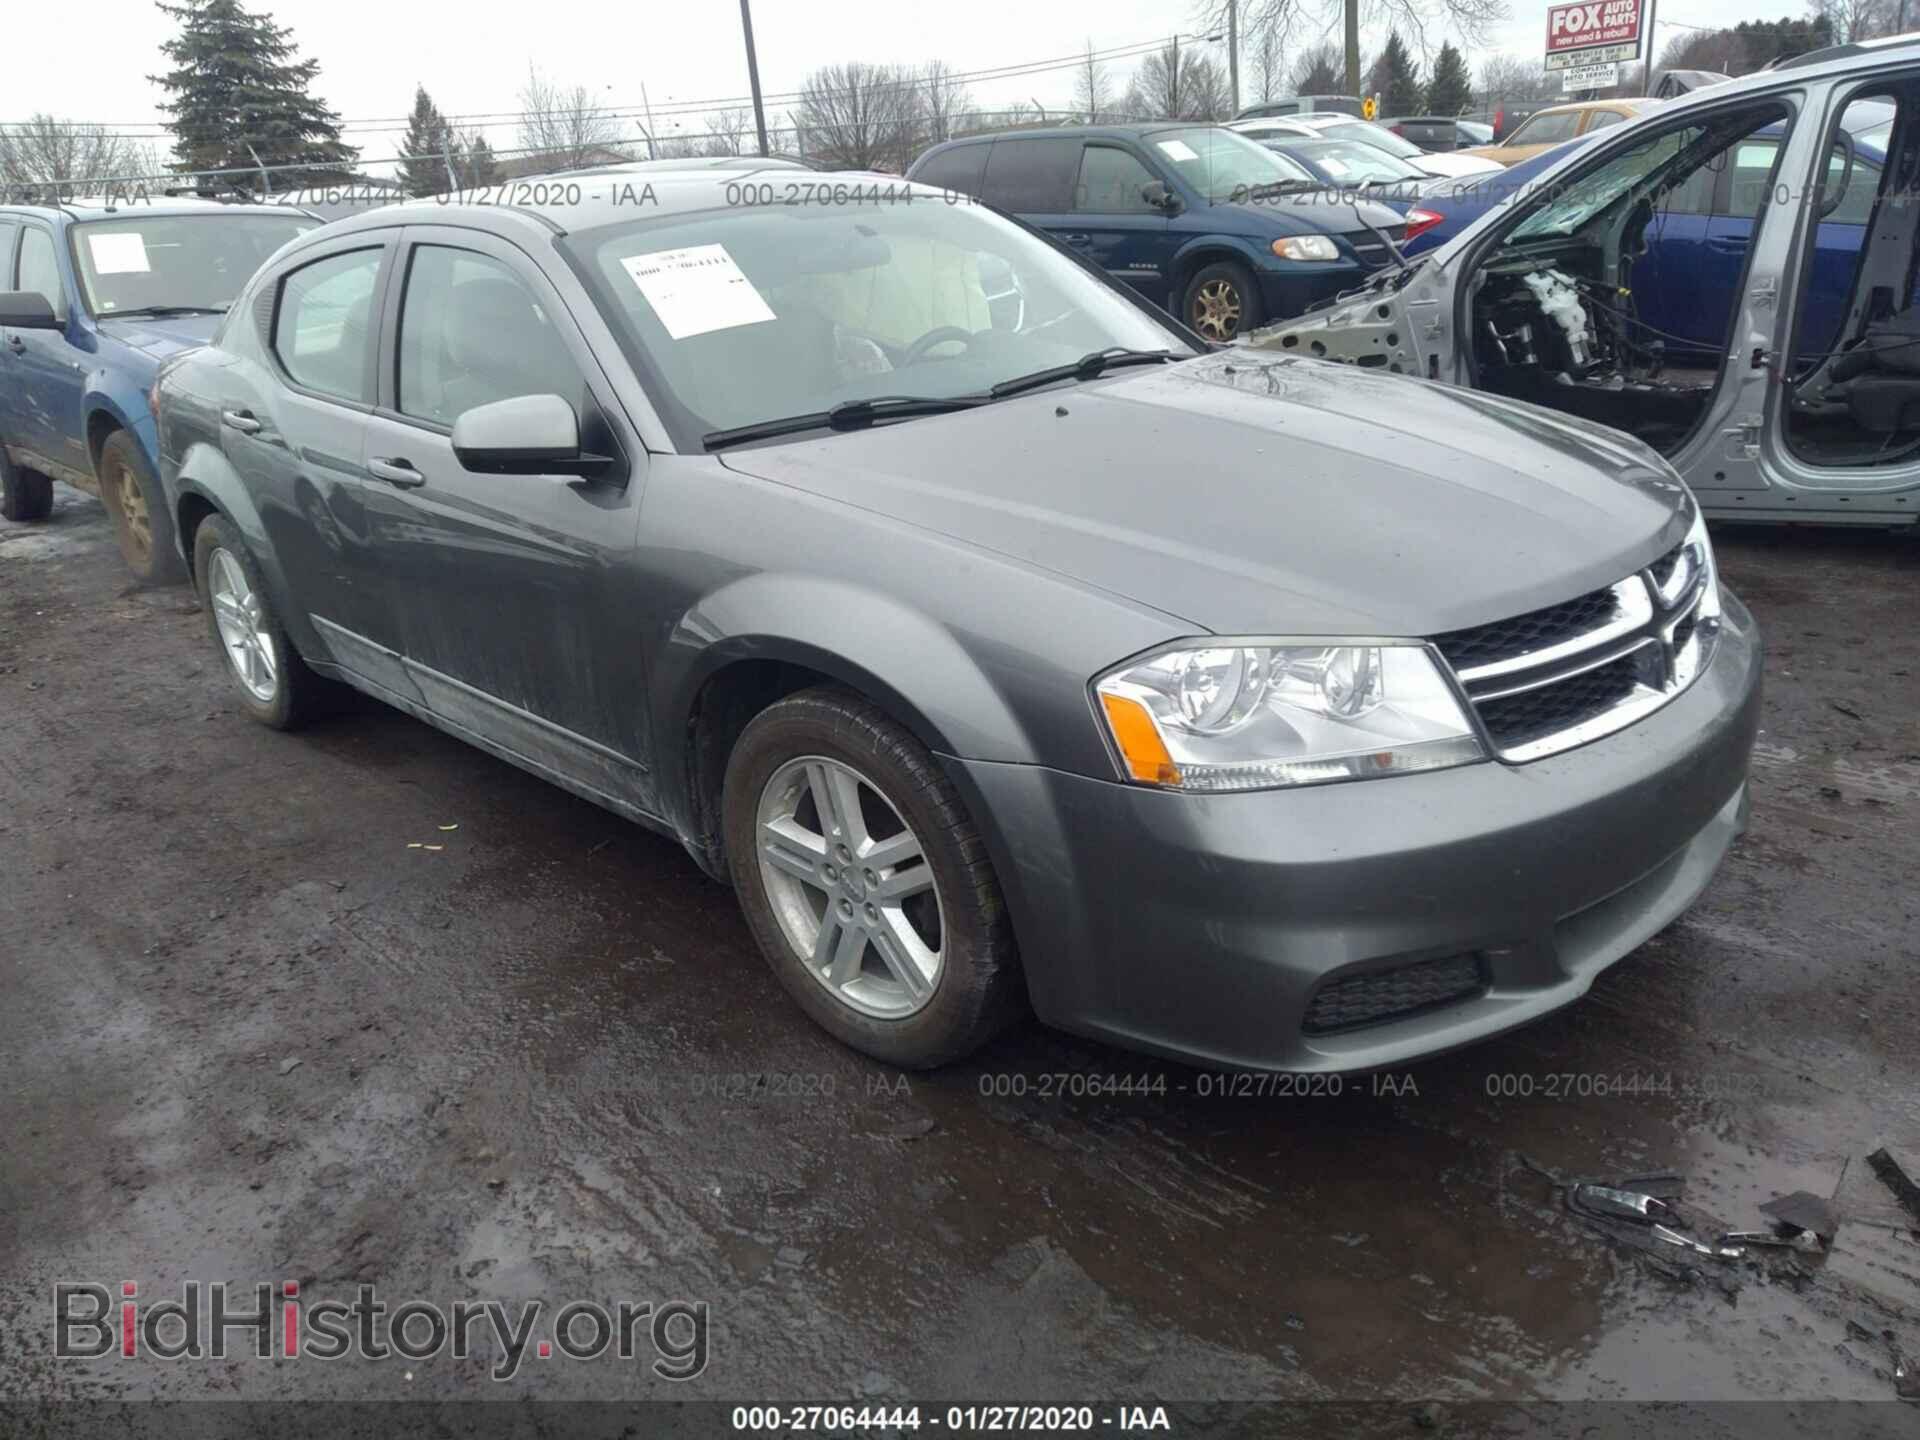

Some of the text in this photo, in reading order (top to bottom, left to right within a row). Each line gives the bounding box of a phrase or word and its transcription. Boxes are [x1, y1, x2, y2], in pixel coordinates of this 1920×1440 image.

[1604, 1, 1633, 14] AUTO
[1552, 4, 1602, 34] FOX
[1603, 11, 1636, 27] PARTS
[1556, 36, 1573, 45] new
[1575, 32, 1594, 42] used
[1595, 30, 1601, 39] &
[1570, 65, 1607, 73] COMPLETE
[1586, 70, 1614, 78] SERVICE
